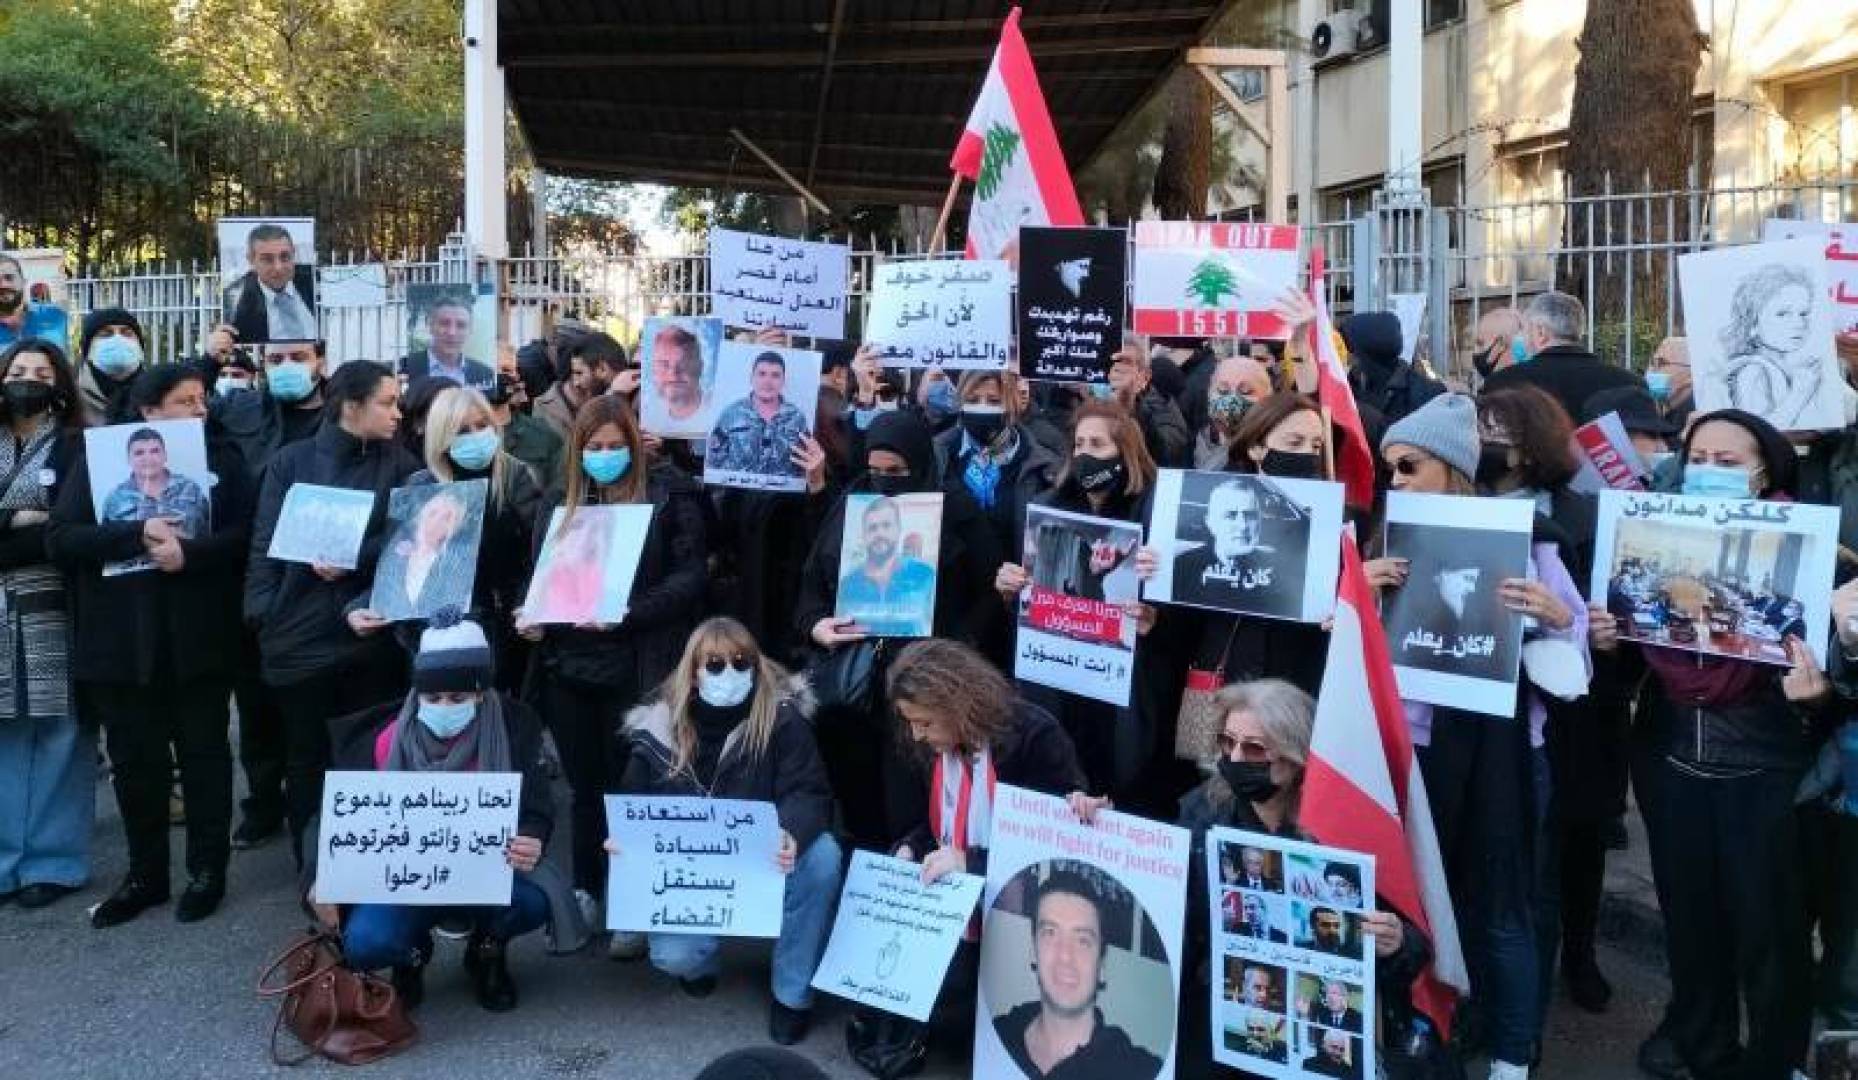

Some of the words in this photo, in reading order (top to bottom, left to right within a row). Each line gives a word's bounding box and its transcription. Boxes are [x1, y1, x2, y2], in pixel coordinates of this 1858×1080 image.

[1227, 223, 1275, 249] OUT
[896, 301, 939, 328] الحق
[874, 344, 914, 362] مع
[921, 338, 1007, 366] والقانون
[333, 790, 392, 816] بدموع
[401, 786, 470, 819] ربيناهم
[477, 785, 513, 809] نحنا
[626, 801, 716, 822] استعادة
[724, 811, 756, 830] من
[654, 833, 739, 863] السيادة
[650, 903, 735, 929] القضاء
